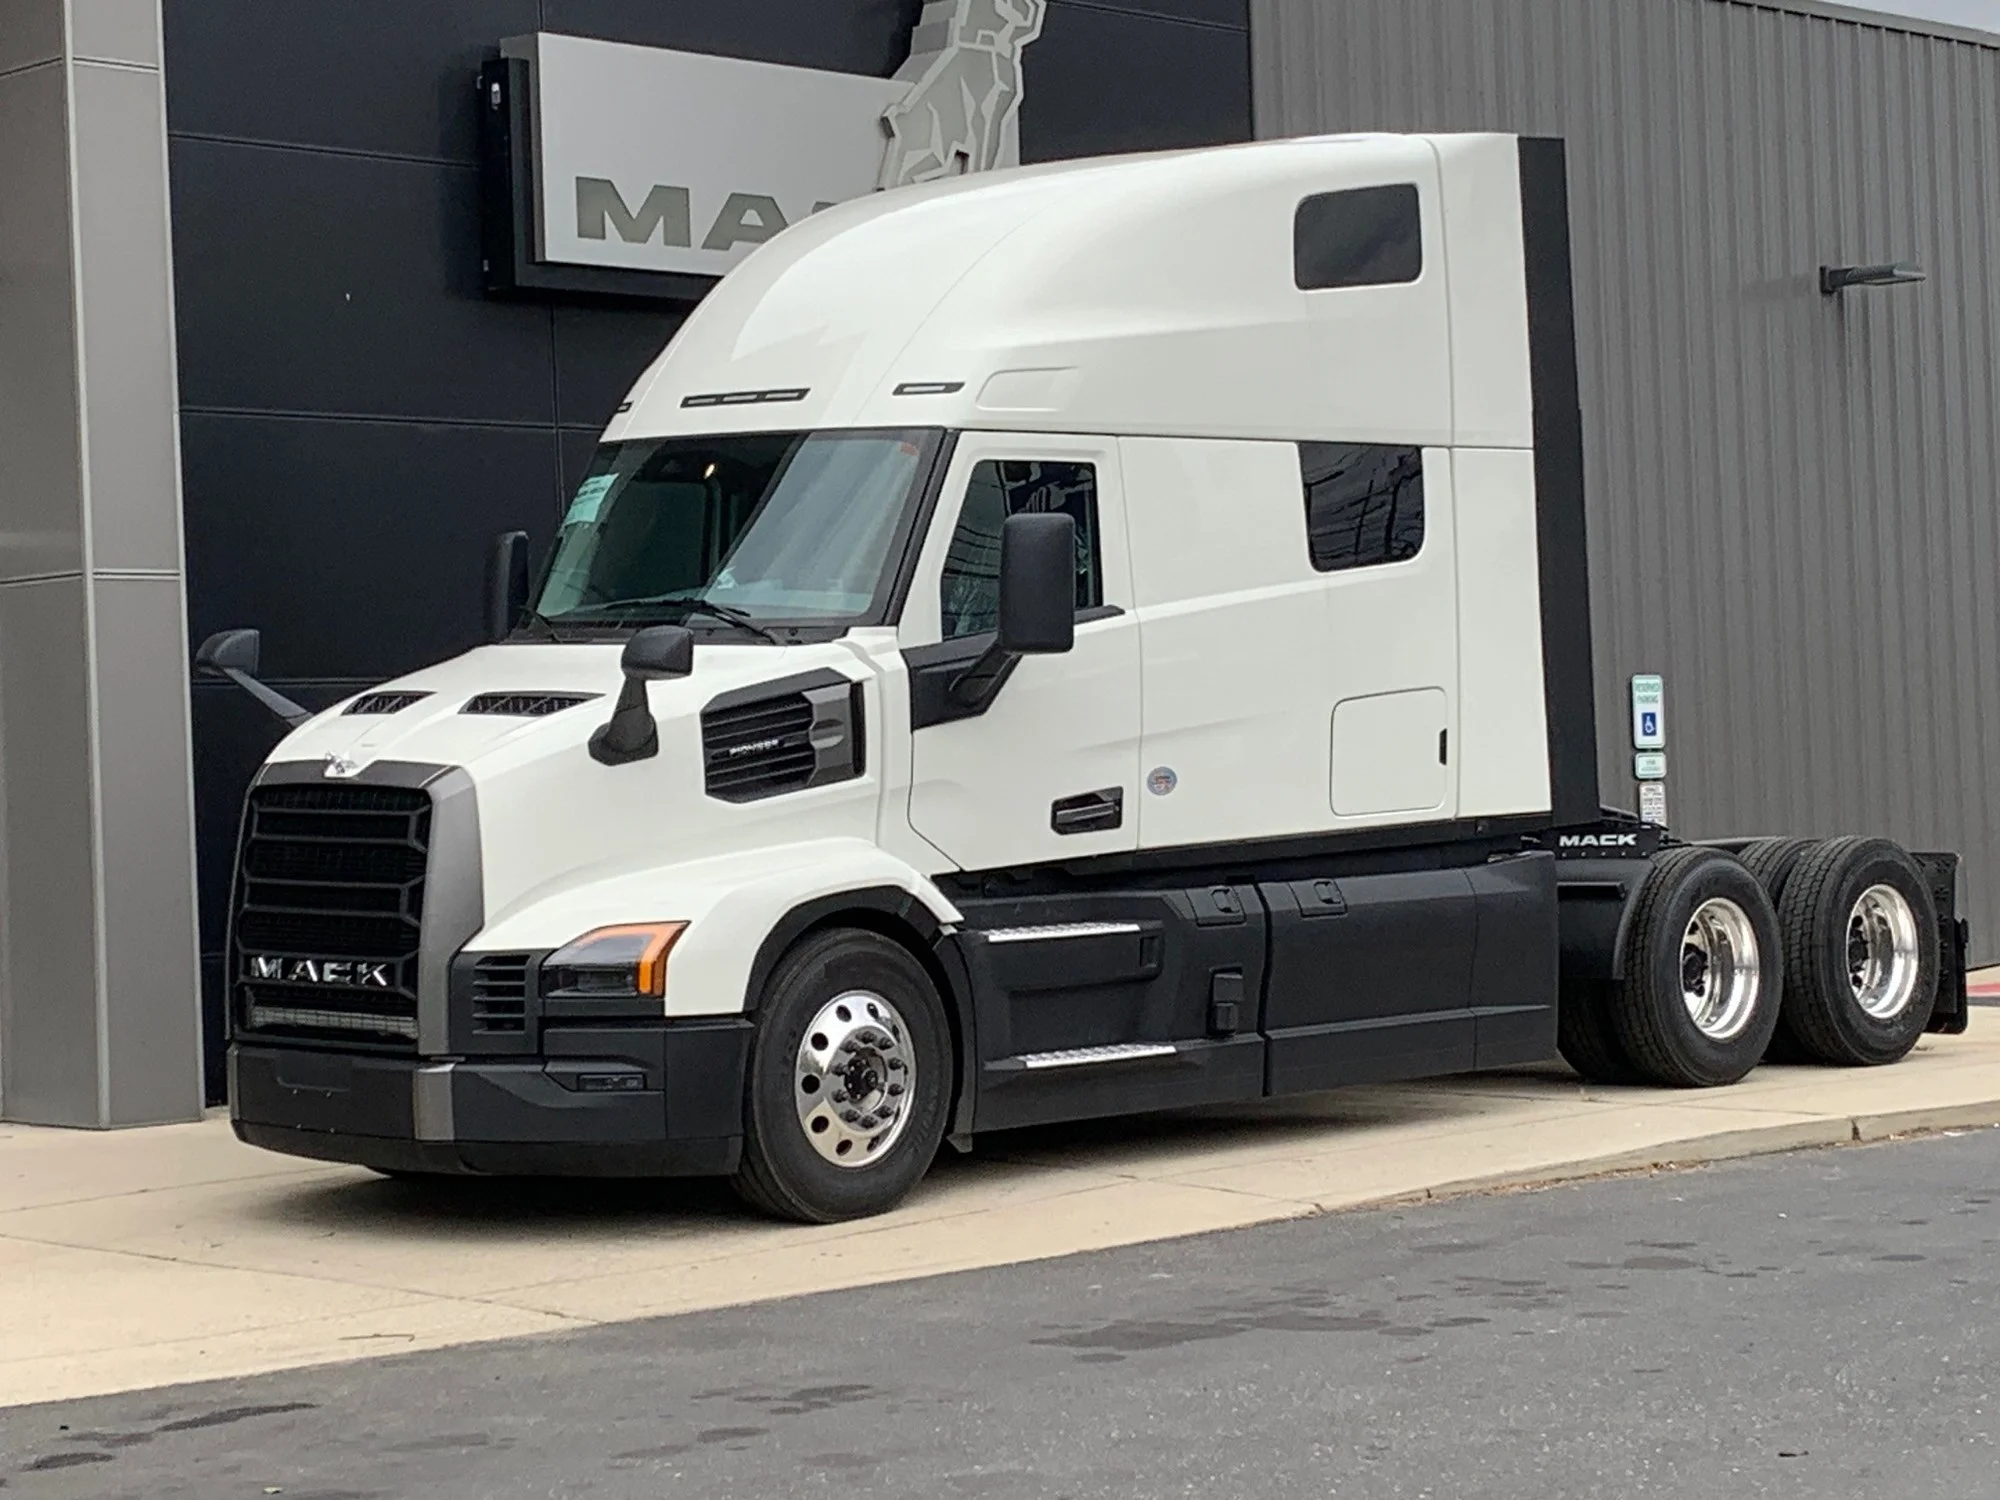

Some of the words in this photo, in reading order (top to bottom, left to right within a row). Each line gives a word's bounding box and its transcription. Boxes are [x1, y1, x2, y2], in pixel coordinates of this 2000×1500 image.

[575, 176, 837, 250] MA
[1559, 834, 1637, 847] MACK
[250, 956, 387, 986] MACK
